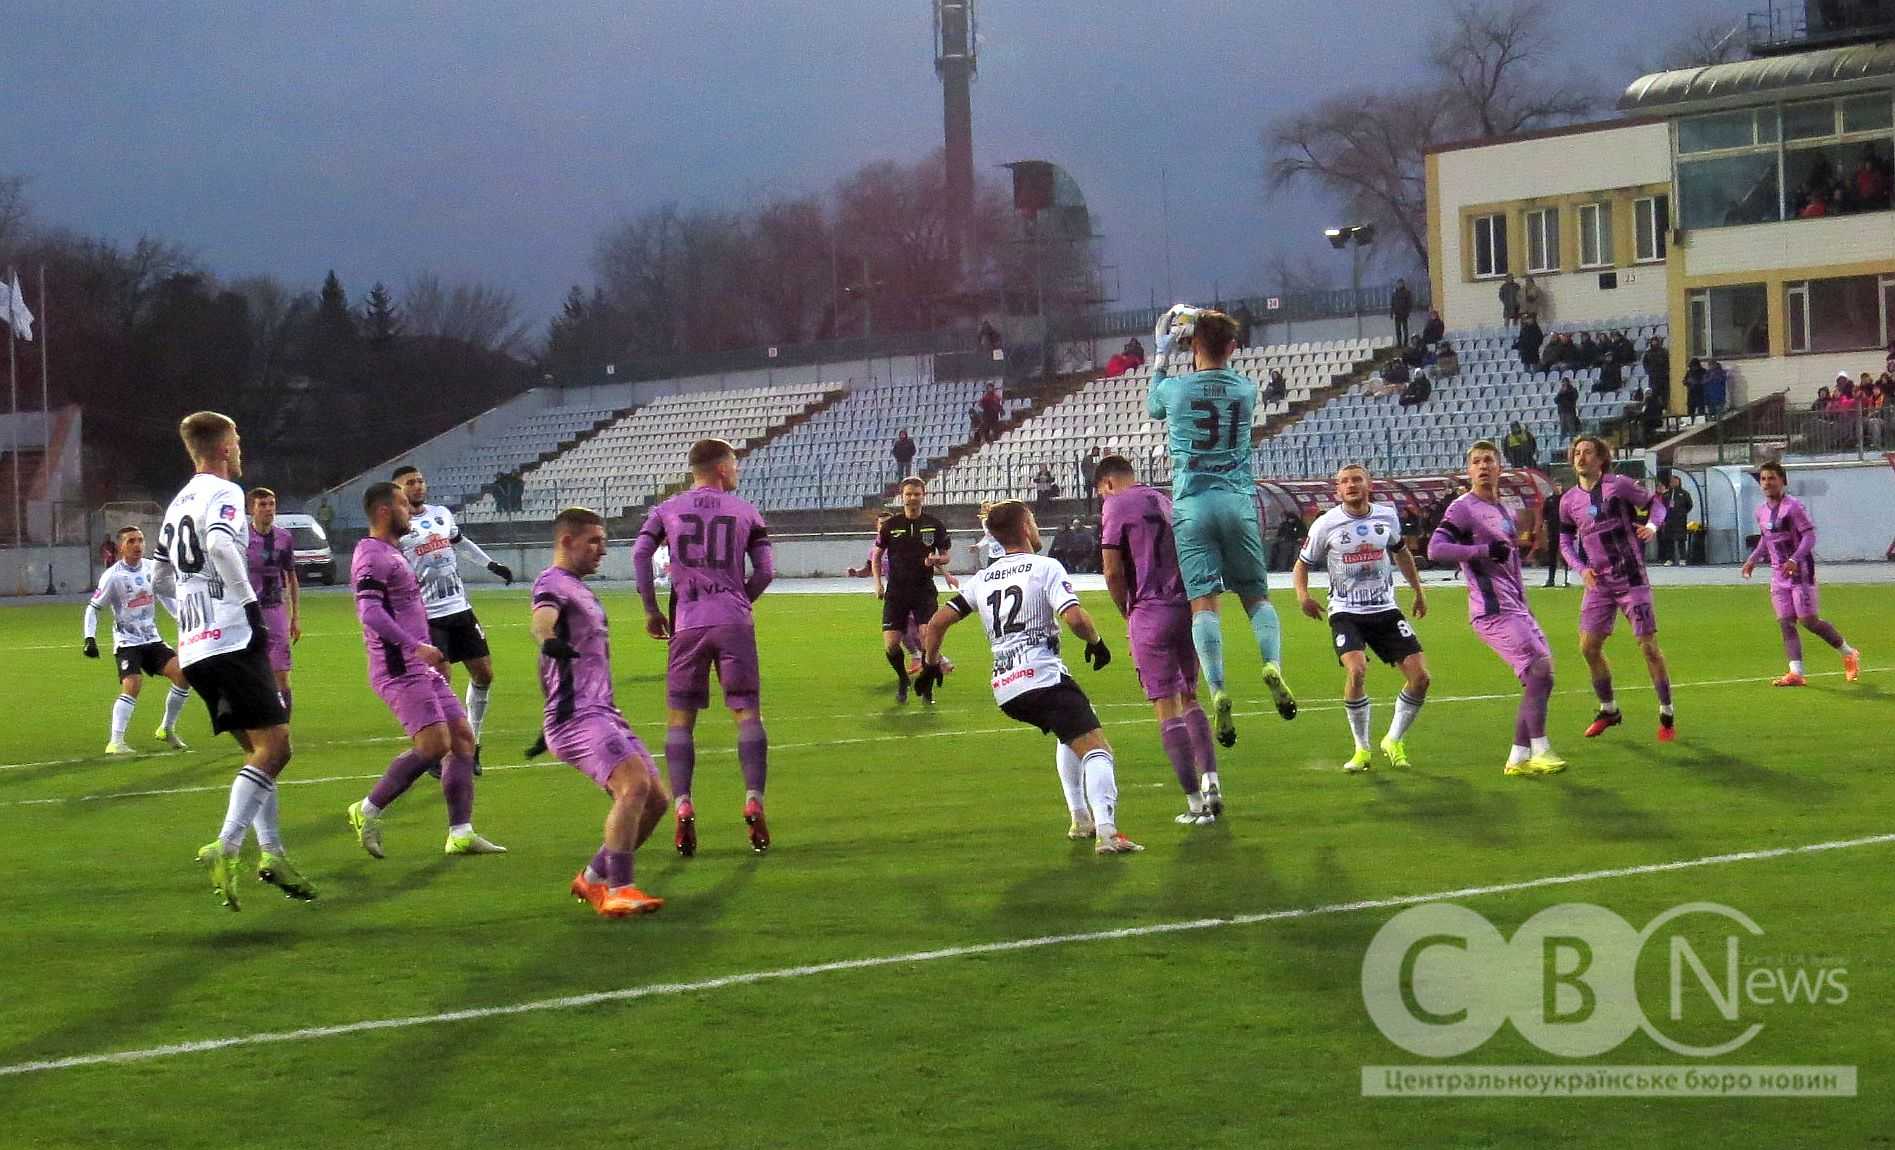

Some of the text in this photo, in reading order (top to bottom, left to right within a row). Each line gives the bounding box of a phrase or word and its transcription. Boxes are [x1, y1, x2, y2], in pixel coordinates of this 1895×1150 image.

[1190, 401, 1240, 449] 31
[678, 514, 737, 569] 20
[984, 563, 1032, 582] САВЕНКОВ
[987, 585, 1026, 639] 12
